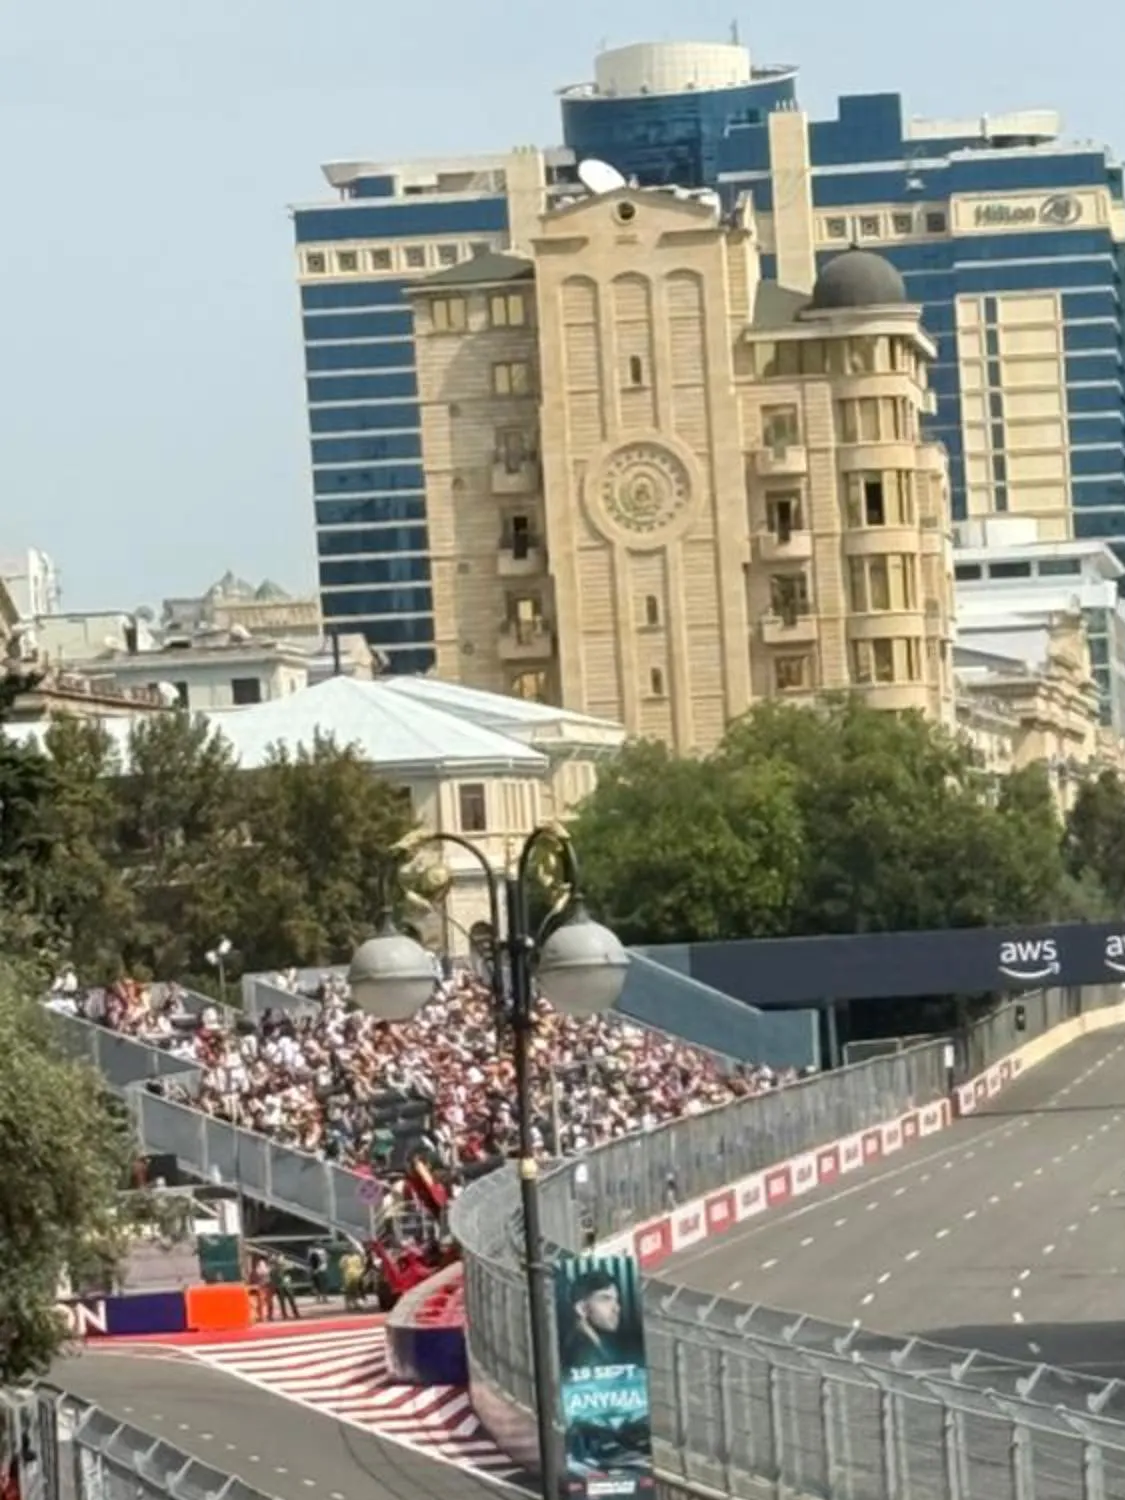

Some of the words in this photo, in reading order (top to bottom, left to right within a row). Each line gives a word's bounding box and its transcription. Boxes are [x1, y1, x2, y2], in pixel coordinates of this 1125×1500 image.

[974, 203, 1036, 226] Hilton
[1000, 939, 1057, 963] aws
[570, 1387, 645, 1410] ANYMA
